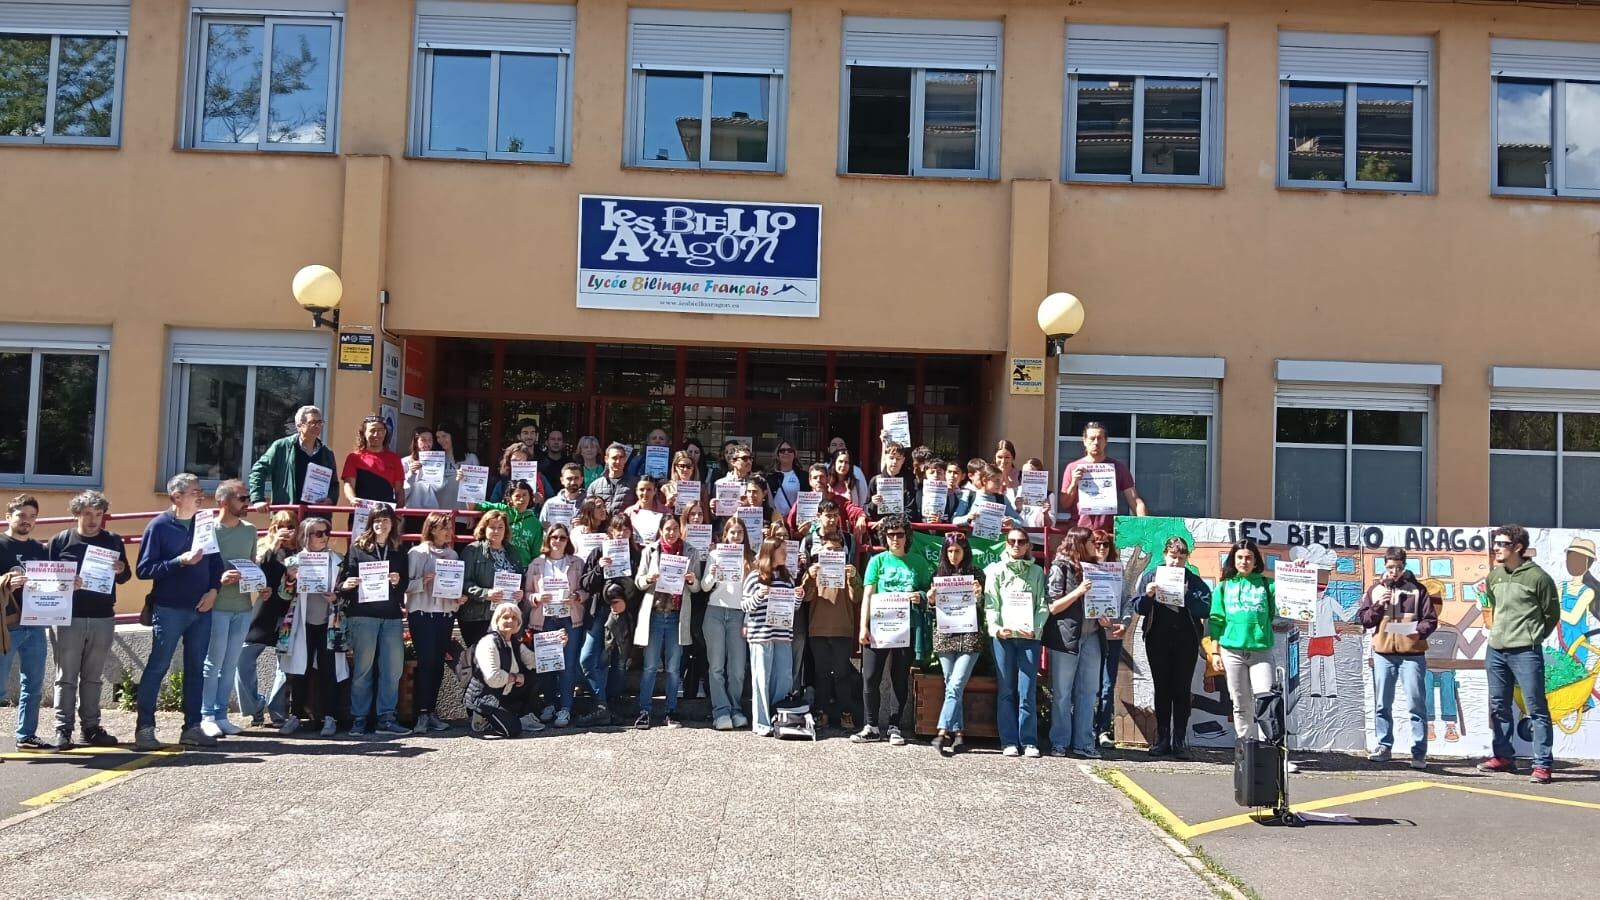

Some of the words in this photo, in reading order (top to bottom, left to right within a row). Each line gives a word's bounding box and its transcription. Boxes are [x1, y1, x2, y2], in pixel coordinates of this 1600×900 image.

[587, 274, 628, 290] Lycée
[631, 276, 700, 295] Bilingue
[704, 279, 769, 297] Français
